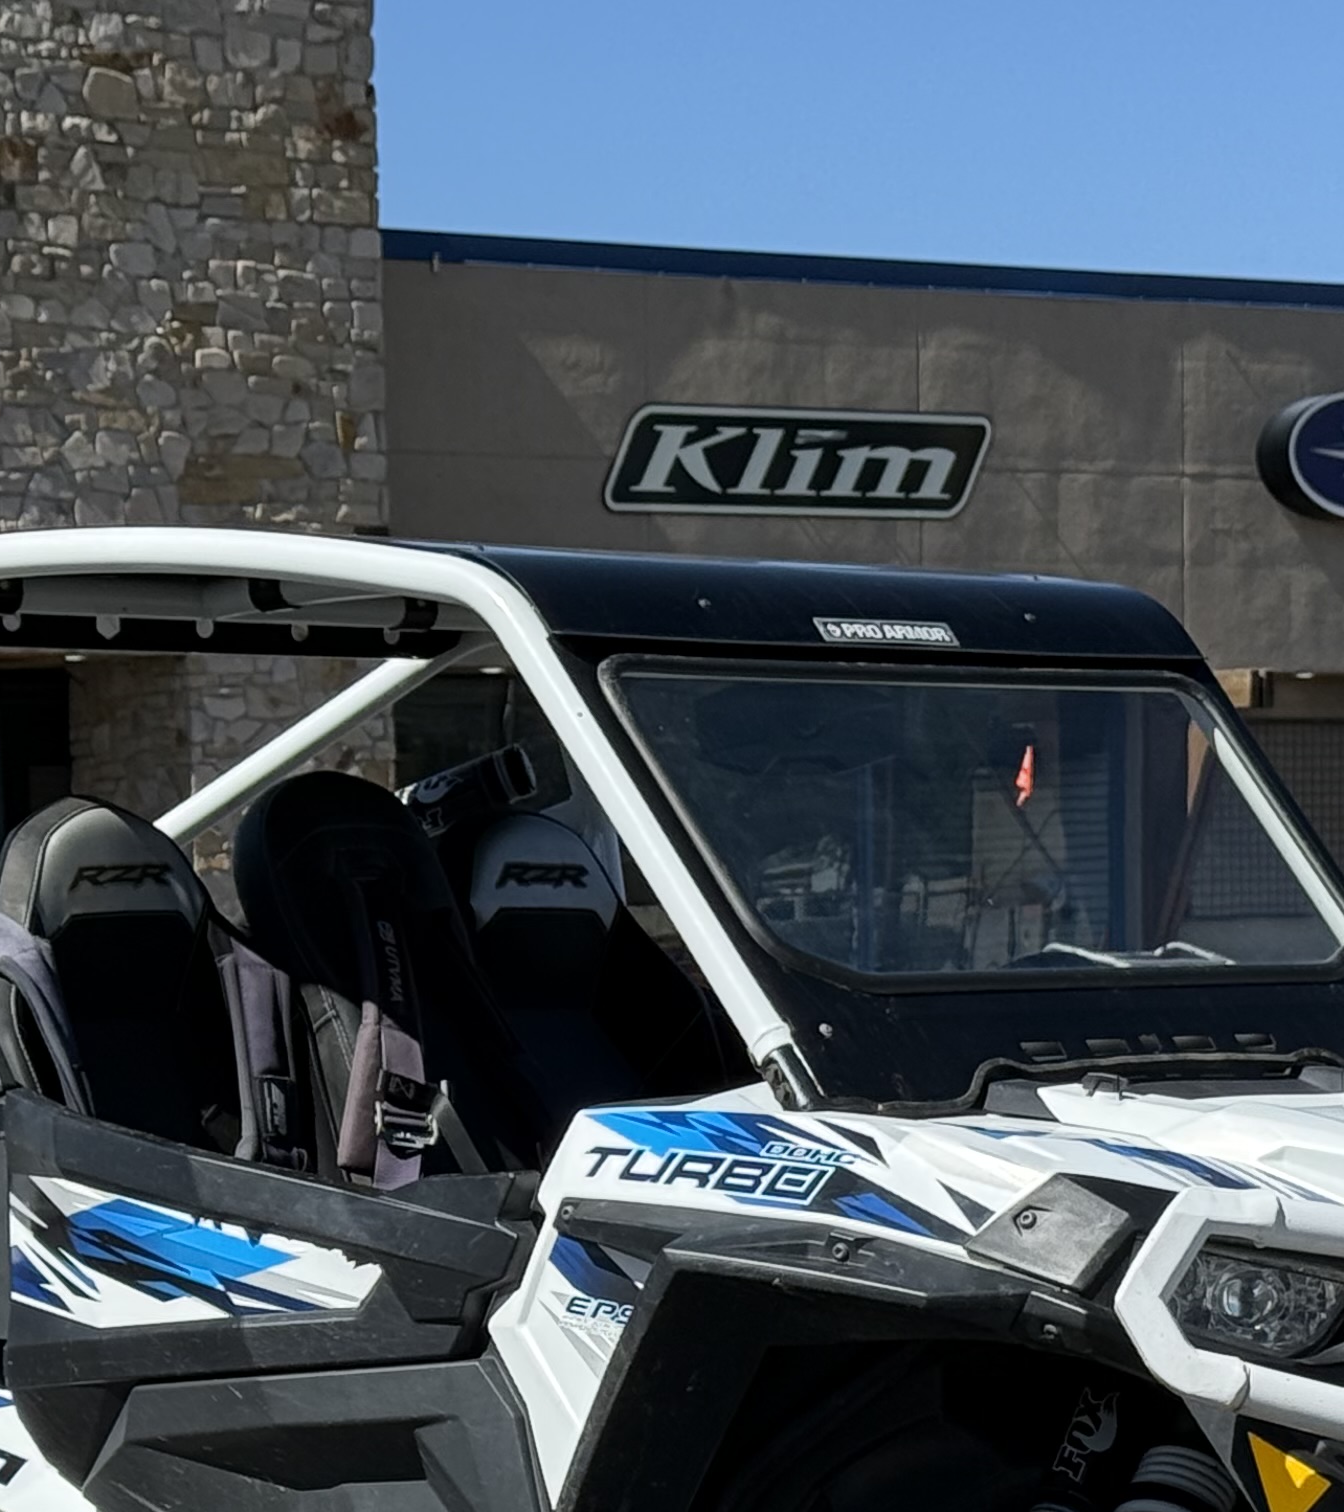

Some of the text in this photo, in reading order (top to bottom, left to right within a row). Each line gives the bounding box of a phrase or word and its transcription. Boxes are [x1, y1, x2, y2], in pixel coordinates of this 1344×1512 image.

[840, 622, 952, 642] PRO ARMOR
[68, 863, 173, 892] RZR
[495, 861, 590, 890] RZR
[586, 1145, 831, 1203] TURBO
